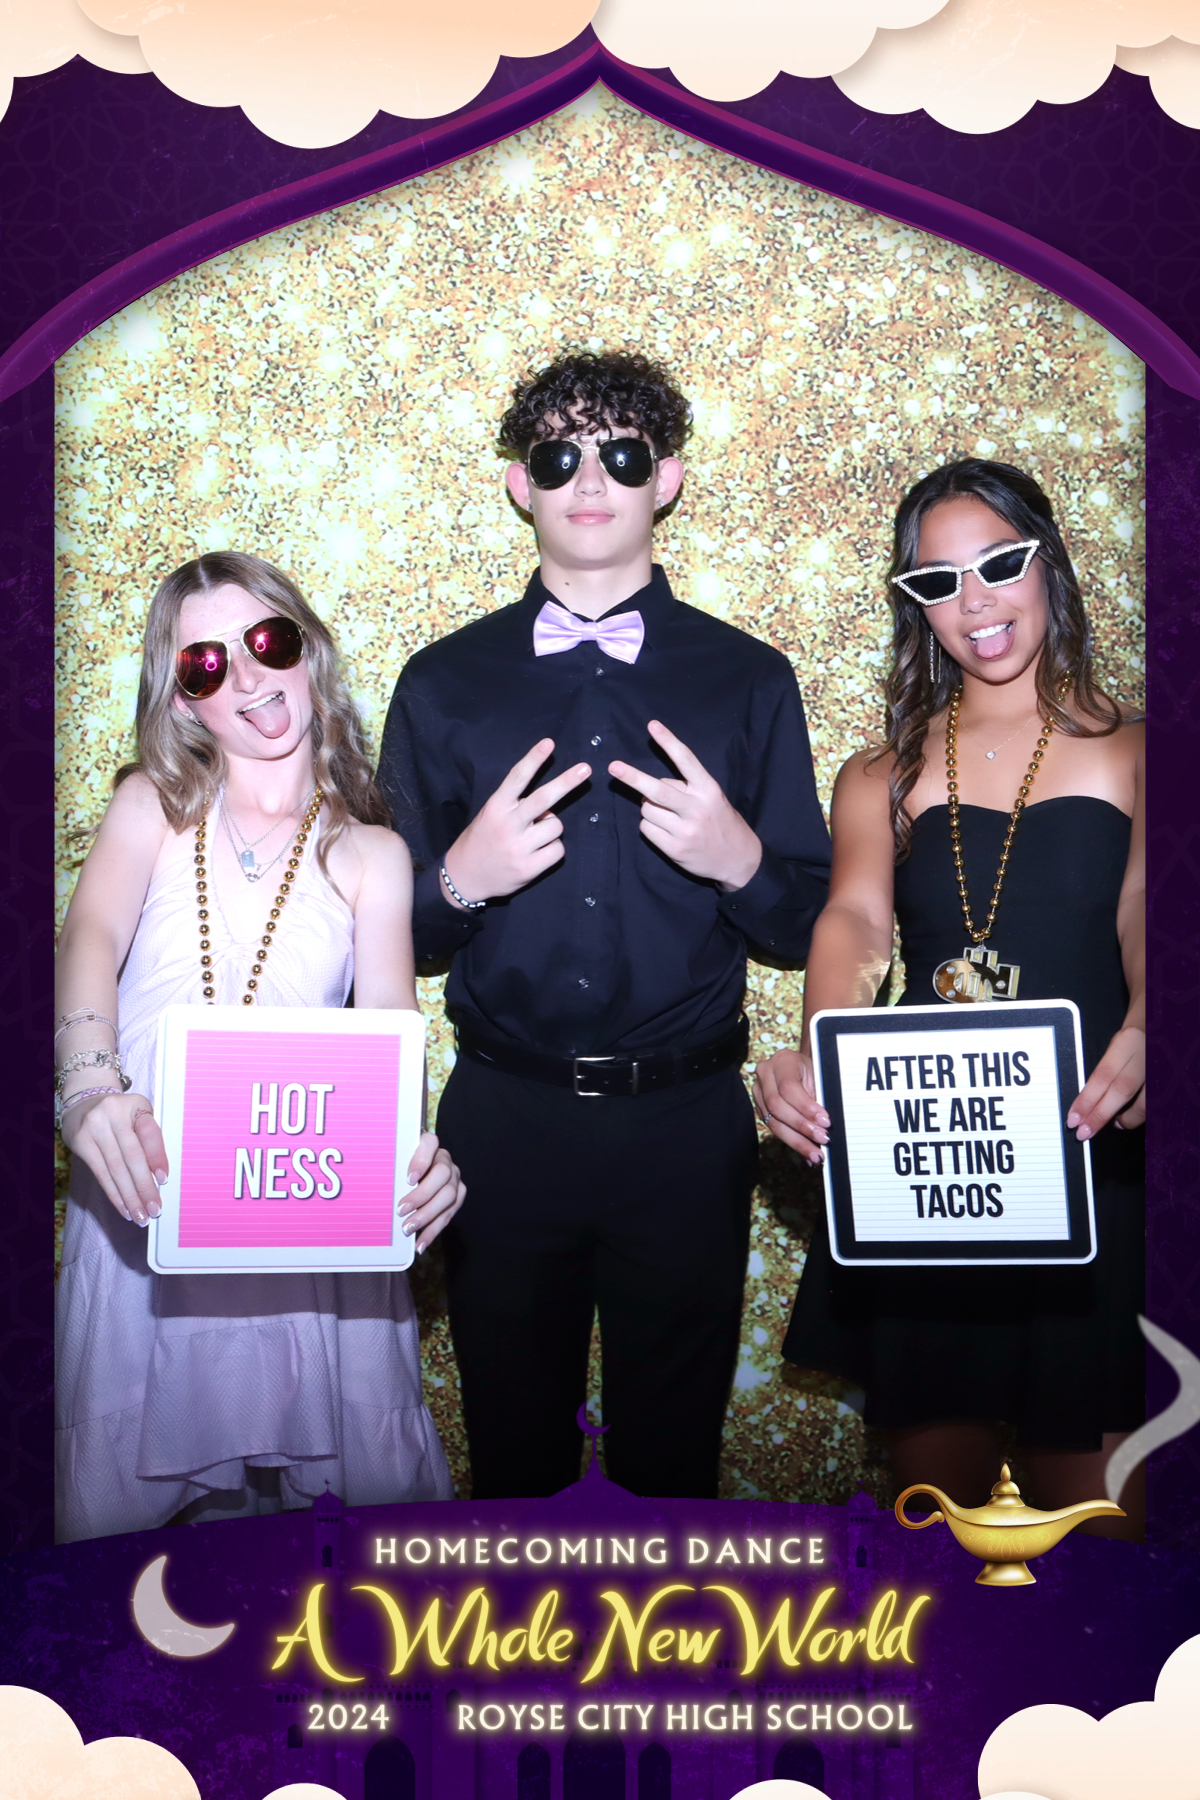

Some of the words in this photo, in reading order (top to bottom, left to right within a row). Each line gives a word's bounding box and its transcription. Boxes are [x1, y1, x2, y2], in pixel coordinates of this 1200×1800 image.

[865, 1054, 956, 1091] AFTER
[962, 1051, 1031, 1087] THIS
[250, 1082, 335, 1135] HOT
[893, 1098, 940, 1133] WE
[949, 1096, 1007, 1132] ARE
[234, 1147, 344, 1200] NESS
[893, 1139, 1015, 1176] GETTING
[910, 1183, 1004, 1218] TACOS
